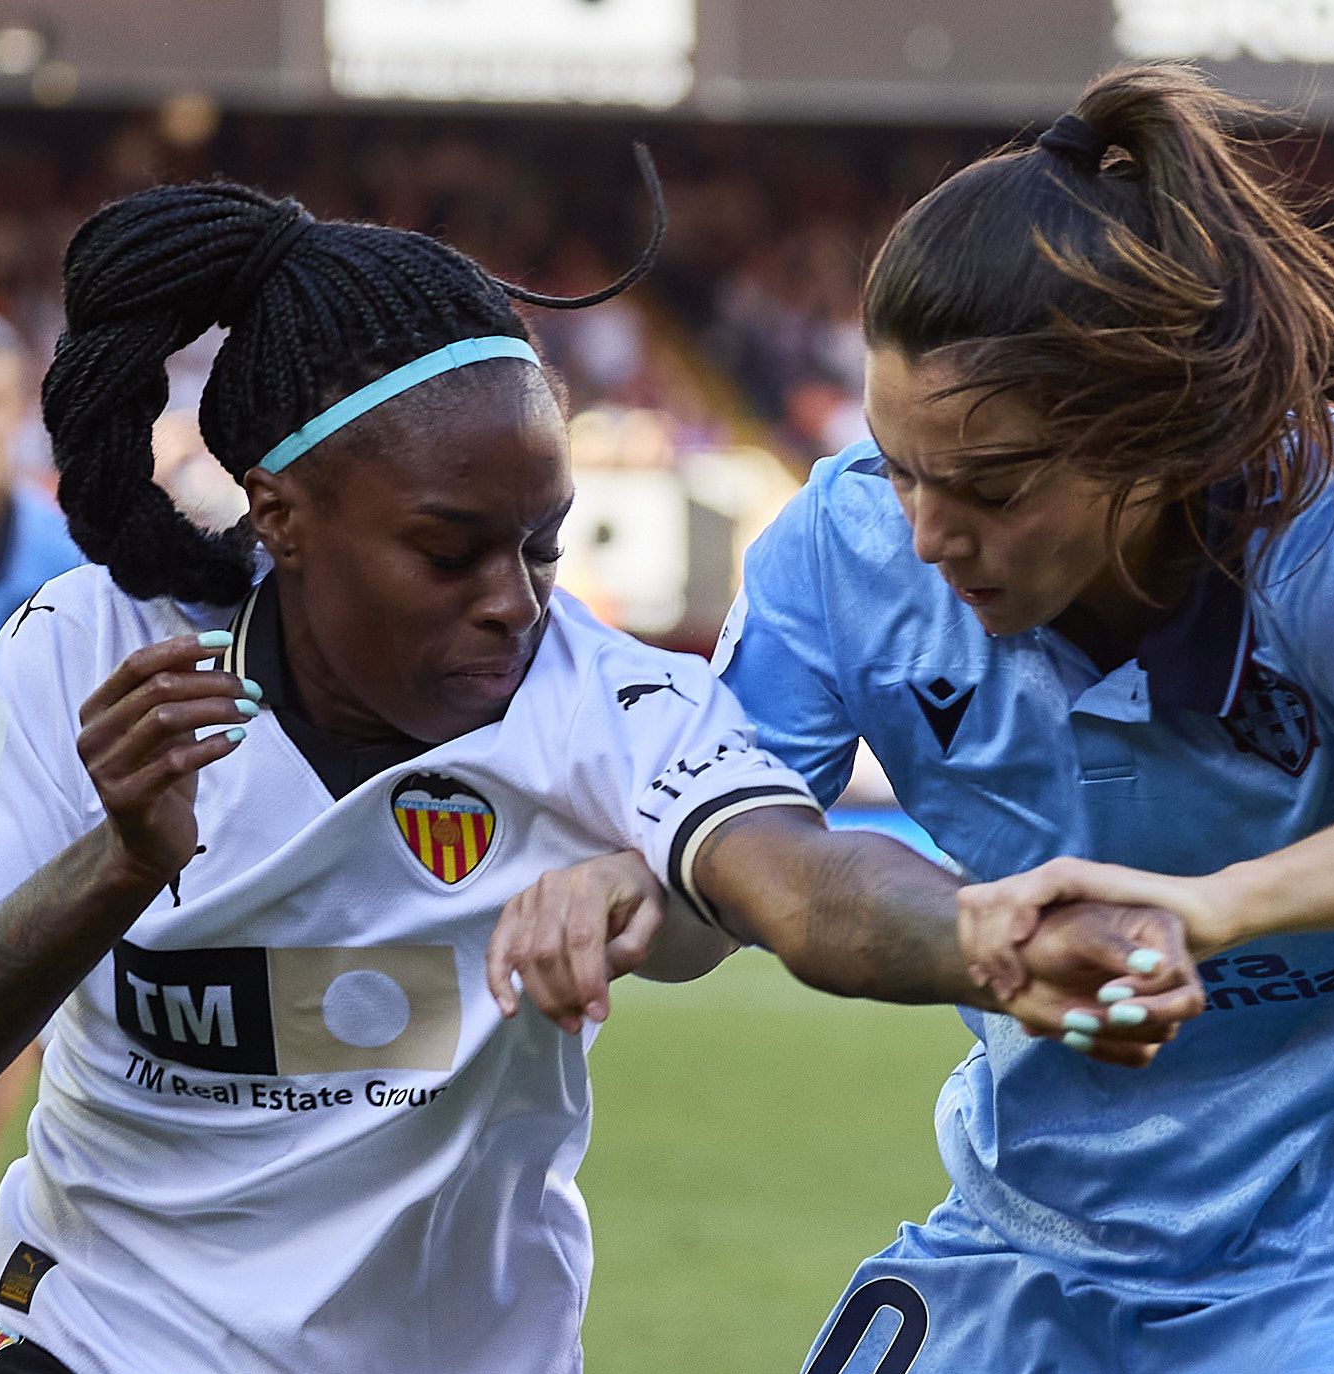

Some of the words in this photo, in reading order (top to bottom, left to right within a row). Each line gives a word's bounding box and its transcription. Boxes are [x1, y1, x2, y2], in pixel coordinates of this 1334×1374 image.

[1197, 953, 1289, 983] ra
[125, 970, 239, 1048] TM
[125, 1051, 166, 1093] TM
[171, 1074, 239, 1105] Real
[250, 1082, 354, 1112] Estate
